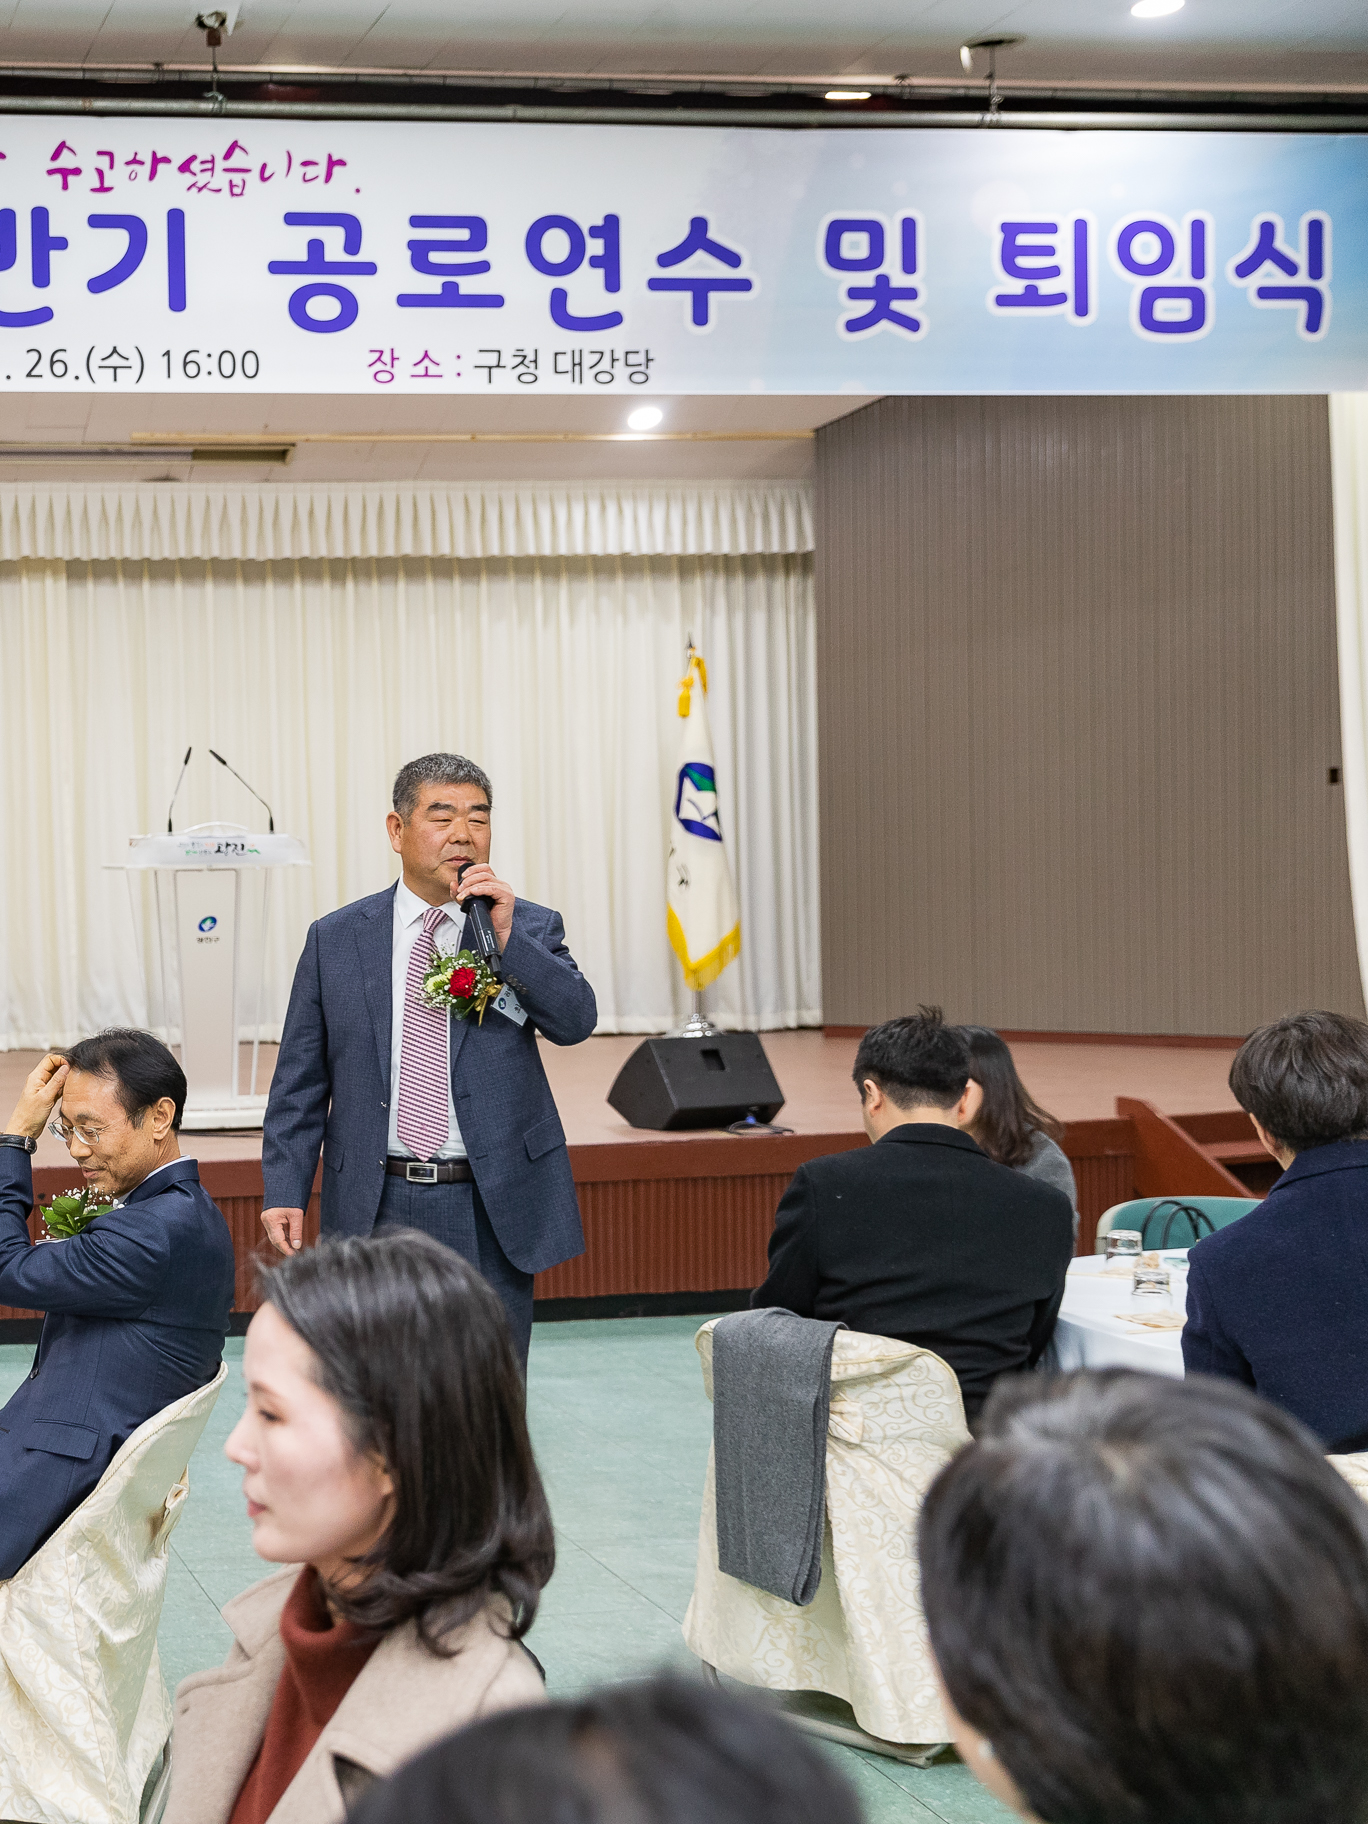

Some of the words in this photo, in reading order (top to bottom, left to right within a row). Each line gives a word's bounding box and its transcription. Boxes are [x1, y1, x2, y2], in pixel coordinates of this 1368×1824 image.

[45, 139, 362, 198] 수고하셨습니다.
[267, 211, 754, 334] 공로연수
[824, 216, 922, 333] 및
[994, 218, 1325, 335] 퇴임식
[161, 348, 261, 379] 16:00
[473, 348, 540, 384] 구청
[553, 349, 656, 385] 대강당
